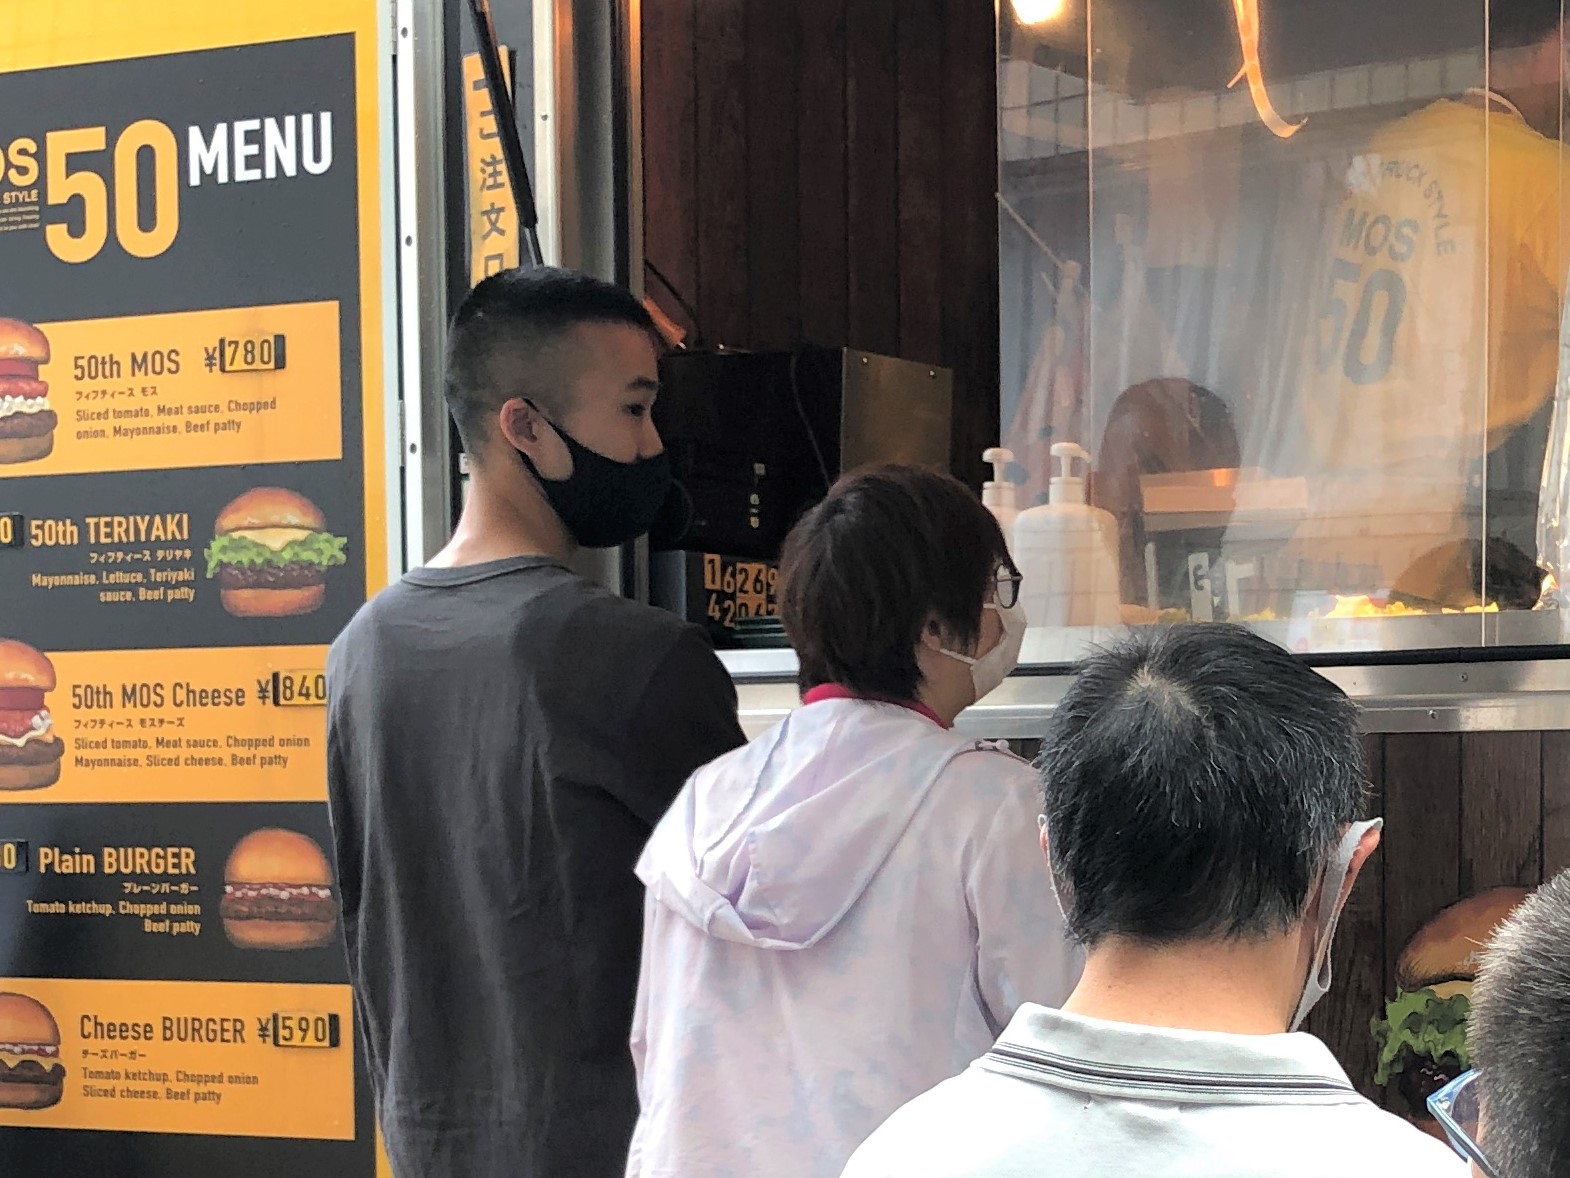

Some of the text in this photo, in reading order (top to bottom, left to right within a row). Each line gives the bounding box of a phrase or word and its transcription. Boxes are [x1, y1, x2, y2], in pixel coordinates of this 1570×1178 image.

[0, 111, 332, 263] S 50 MENU
[3, 189, 39, 204] STYLE
[1340, 207, 1420, 263] MOS
[1316, 257, 1407, 385] 50
[74, 354, 121, 381] 50th
[131, 349, 180, 377] MOS
[76, 408, 109, 422] Sliced
[157, 404, 183, 416] Meat
[227, 397, 277, 413] Chopped
[185, 420, 210, 433] Beef
[214, 419, 242, 435] patty
[30, 519, 79, 547] 50th
[85, 513, 189, 544] TERIYAKI
[149, 568, 195, 584] Teriyaki
[138, 587, 164, 601] Beef
[167, 586, 196, 602] patty
[72, 684, 114, 710] 50th
[121, 682, 165, 709] MOS
[172, 682, 246, 708] Cheese
[74, 738, 107, 750] Sliced
[156, 737, 182, 749] Meat
[226, 735, 274, 750] Chopped
[146, 755, 180, 768] Sliced
[231, 754, 256, 767] Beef
[260, 755, 289, 769] patty
[0, 843, 197, 875] 0 Plain BURGER
[26, 900, 66, 914] Tomato
[118, 901, 167, 917] Chopped
[144, 919, 201, 936] Beef patty
[80, 1014, 154, 1041] Cheese
[162, 1016, 246, 1043] BURGER
[80, 1067, 121, 1080] Tomato
[176, 1070, 224, 1086] Chopped
[82, 1085, 116, 1099] Sliced
[166, 1086, 190, 1101] Beef
[194, 1089, 222, 1104] patty
